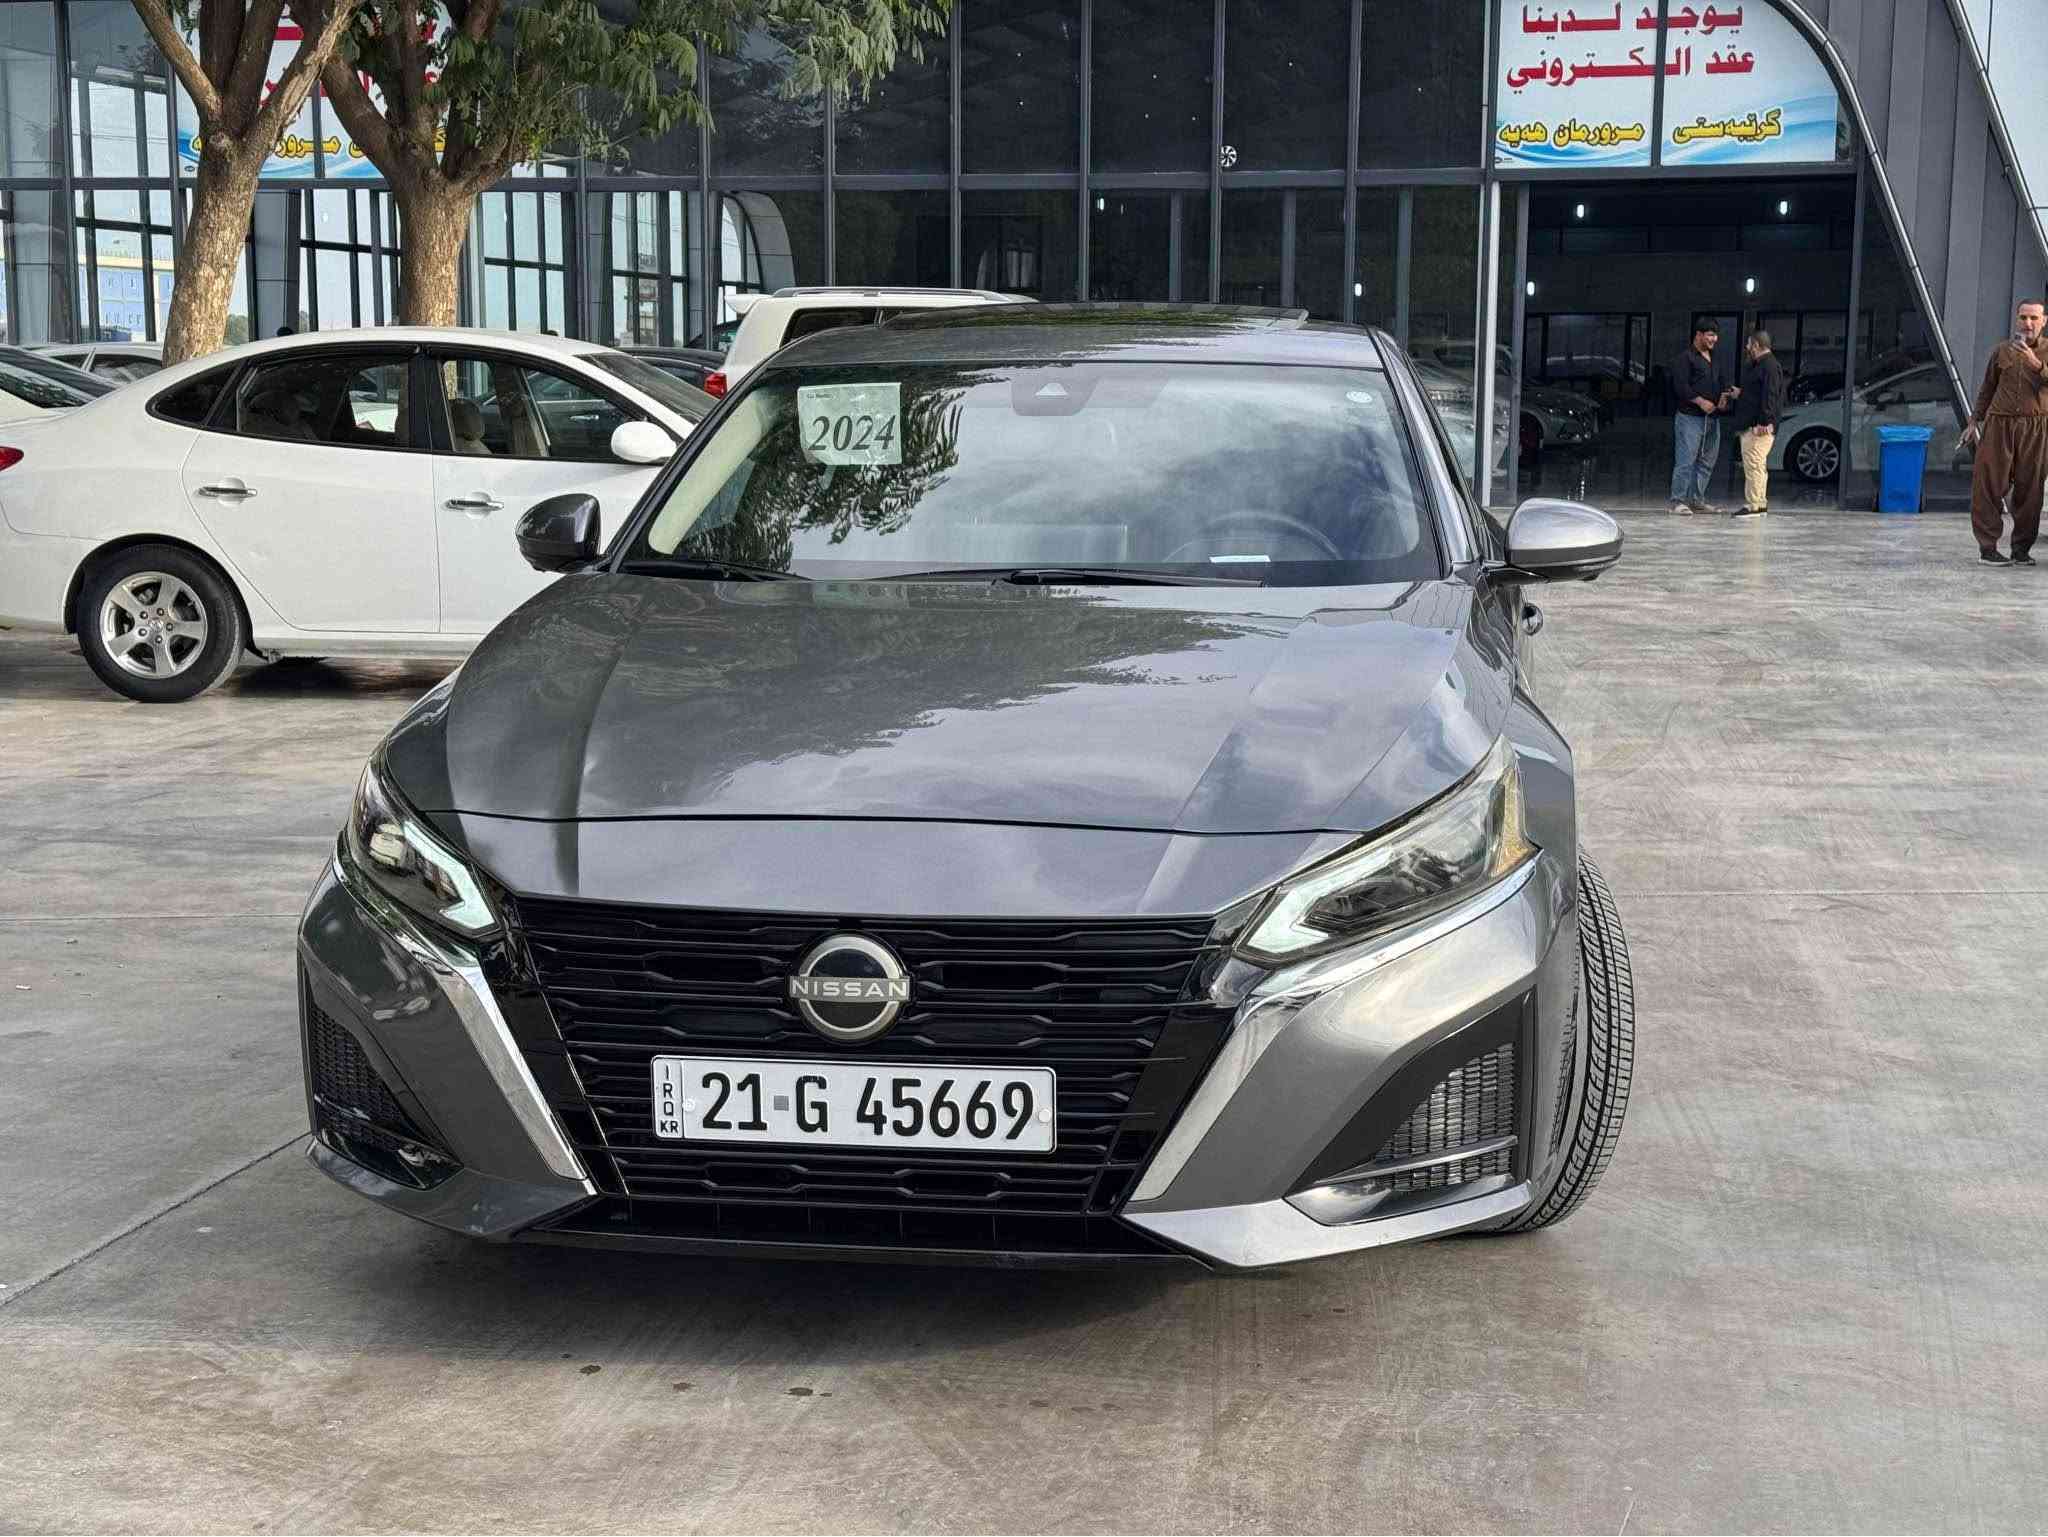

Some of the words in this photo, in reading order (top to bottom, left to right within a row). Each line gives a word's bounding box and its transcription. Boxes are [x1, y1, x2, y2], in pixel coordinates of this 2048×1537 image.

[1522, 2, 1621, 41] لدينا
[1636, 3, 1743, 36] يوجد
[1506, 45, 1691, 95] الكتروني
[1705, 44, 1755, 74] عقد
[808, 414, 896, 452] 2024
[792, 979, 907, 998] NISSAN
[857, 1077, 1034, 1140] 45669
[660, 1120, 679, 1133] KR
